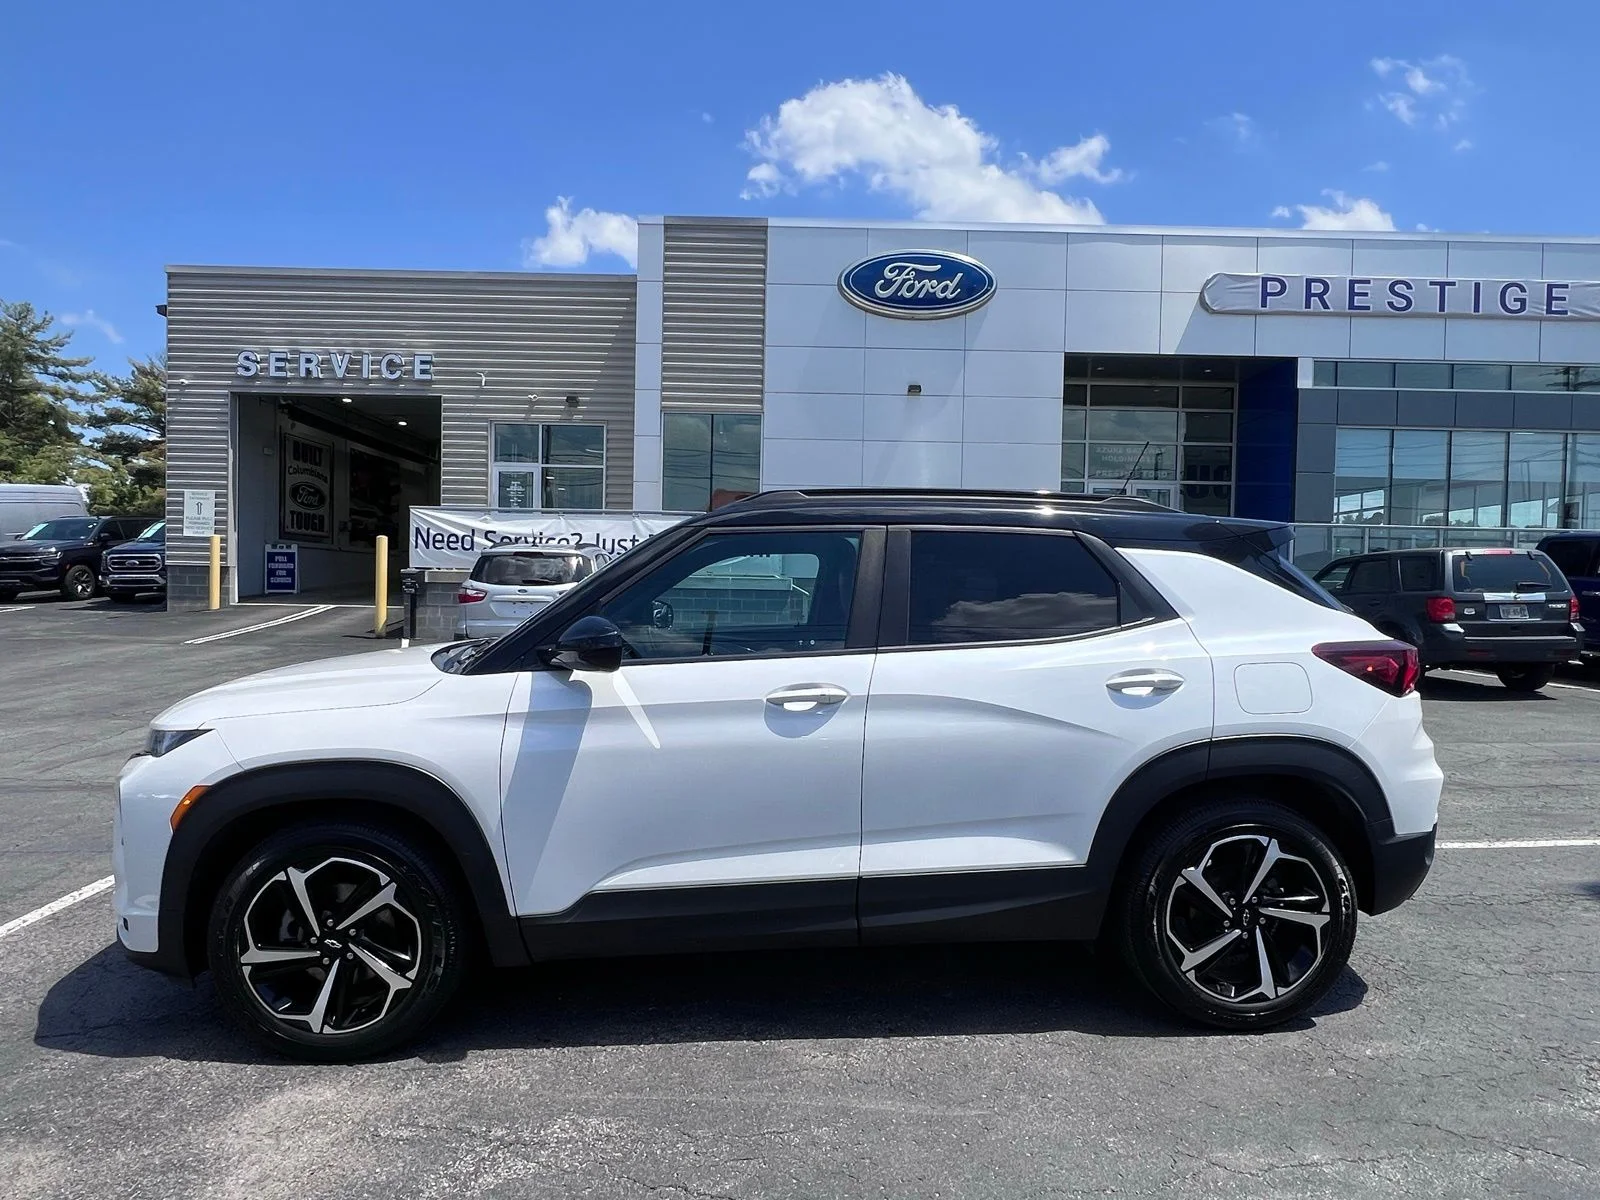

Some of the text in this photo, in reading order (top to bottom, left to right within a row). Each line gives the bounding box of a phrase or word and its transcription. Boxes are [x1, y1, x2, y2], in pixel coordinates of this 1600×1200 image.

[874, 262, 964, 299] Ford
[1260, 276, 1570, 315] PRESTIGE
[236, 349, 434, 380] SERVICE
[296, 485, 320, 506] Ford
[289, 510, 325, 532] TOUGH
[414, 527, 475, 551] Need
[596, 533, 639, 555] Just
